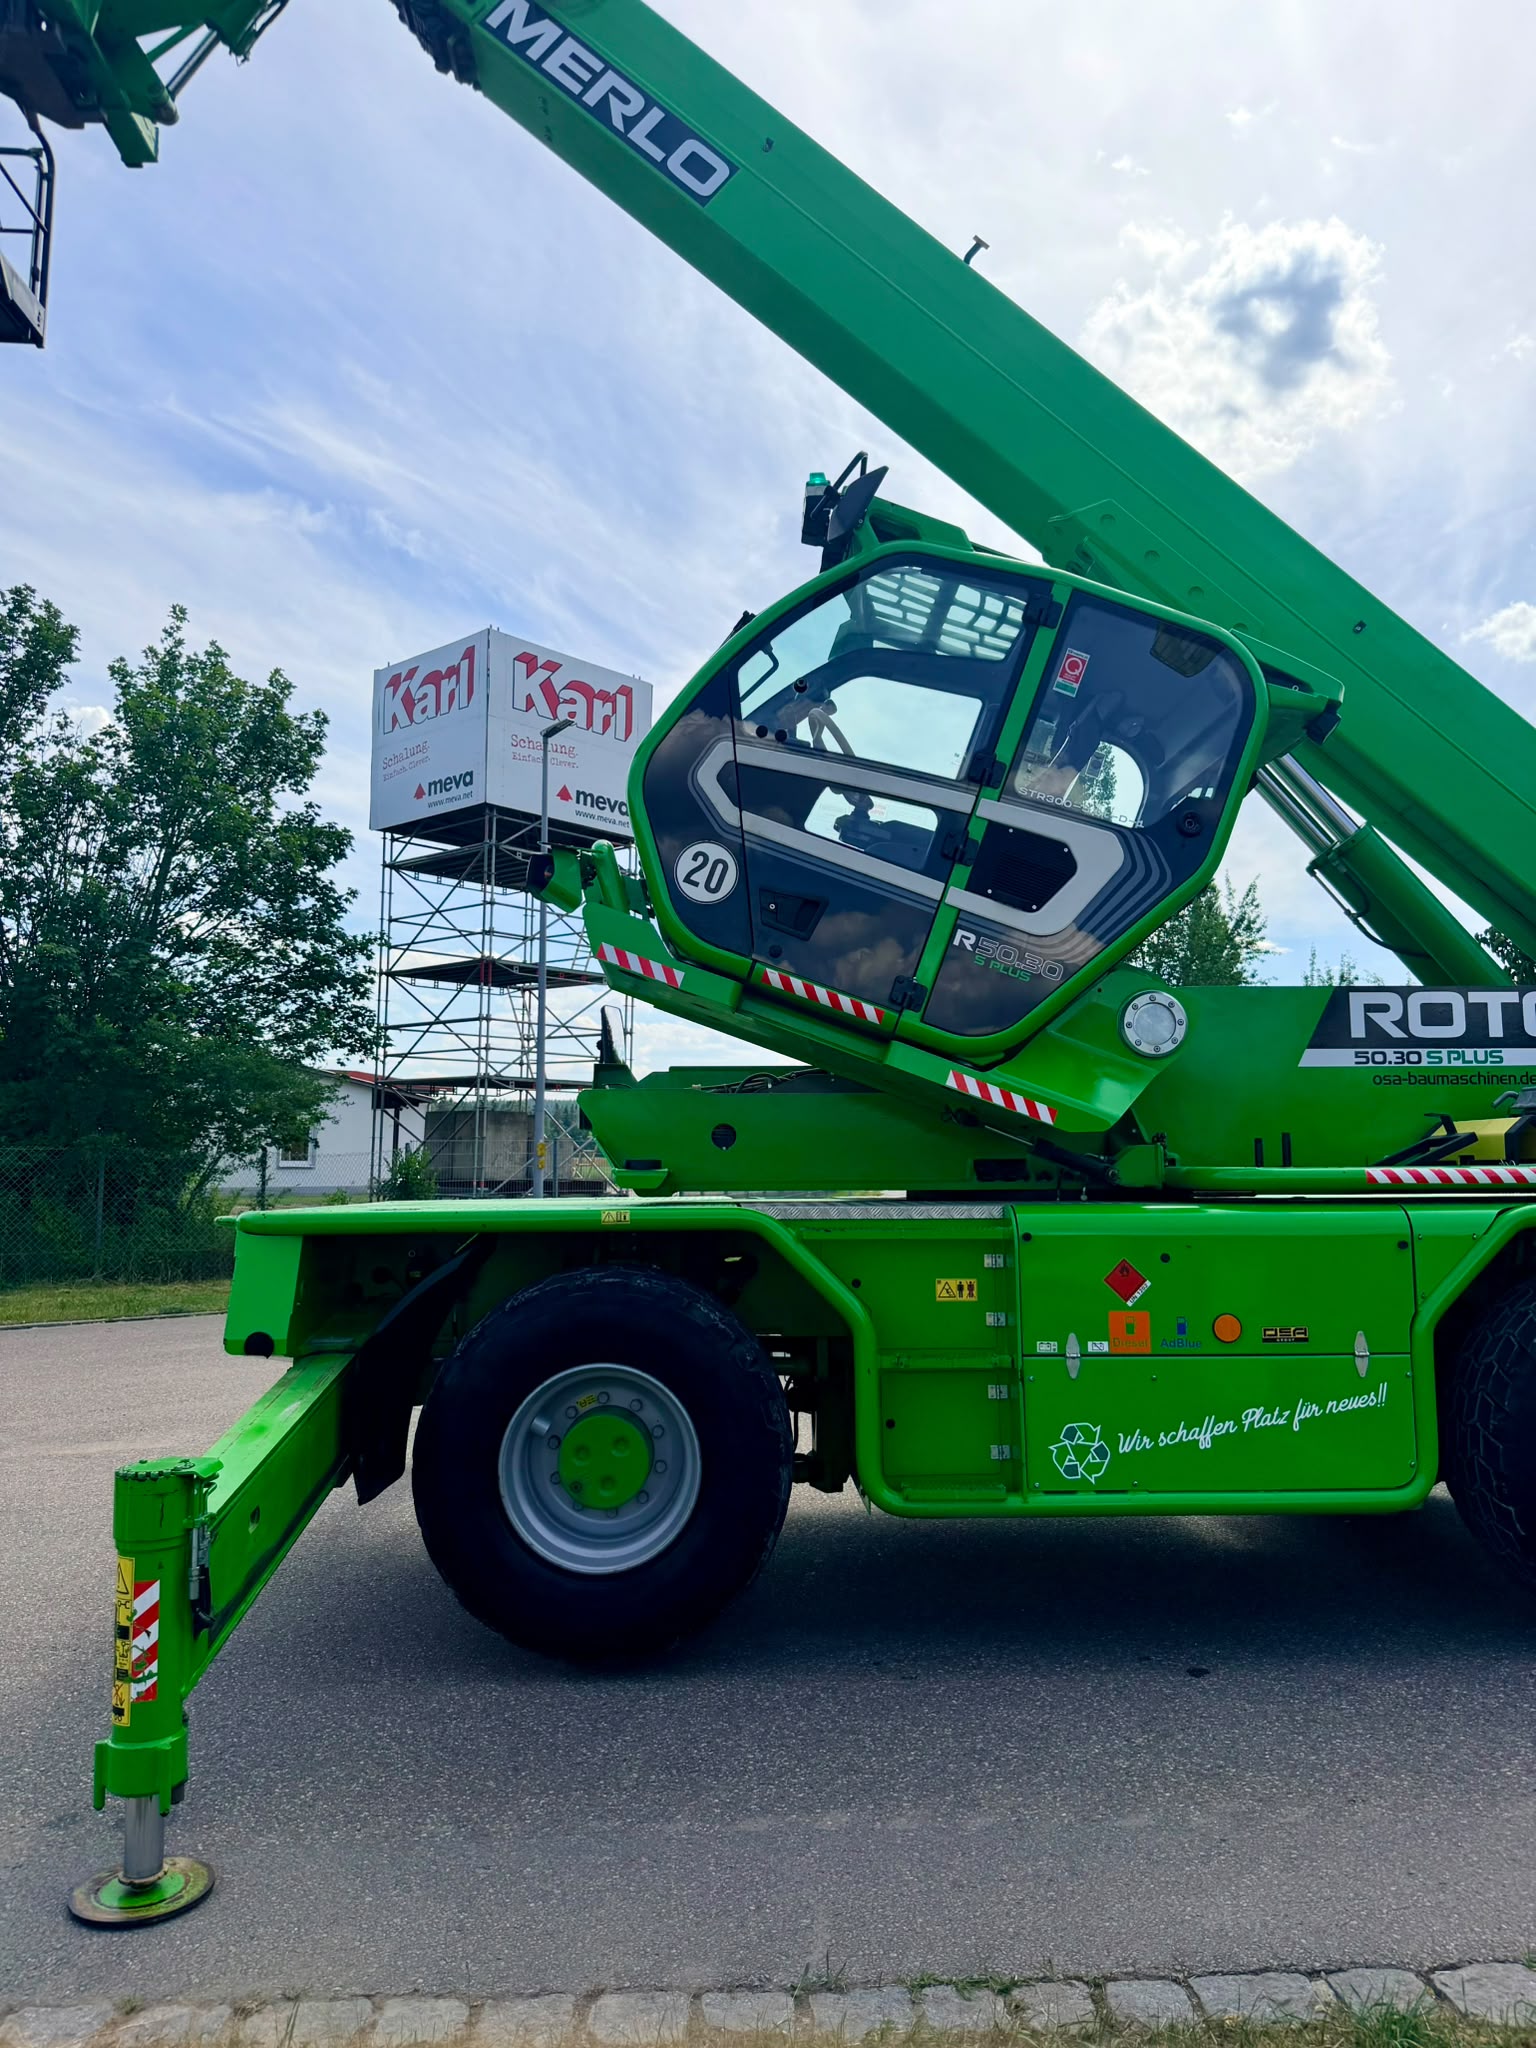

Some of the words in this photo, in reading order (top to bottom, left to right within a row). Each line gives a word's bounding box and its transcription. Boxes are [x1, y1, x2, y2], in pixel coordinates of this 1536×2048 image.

[485, 0, 730, 197] MERLO
[383, 645, 476, 735] Karl
[512, 651, 633, 742] Karl
[382, 740, 430, 770] Schalung.
[511, 734, 579, 759] Schaung.
[551, 757, 579, 769] Clever.
[428, 770, 474, 796] meva
[427, 790, 473, 808] www.meva.net
[575, 789, 630, 817] meva
[575, 809, 630, 828] www.meva.net
[683, 850, 729, 894] 20
[953, 929, 1064, 981] R50.30
[973, 954, 986, 966] S
[989, 959, 1032, 982] PLUS
[1349, 991, 1536, 1039] ROT
[1354, 1051, 1422, 1065] 50.30
[1427, 1050, 1443, 1065] S
[1447, 1050, 1504, 1065] PLUS
[1372, 1071, 1536, 1086] osa-baumaschinen.de
[1112, 1337, 1148, 1348] Diesel
[1160, 1339, 1202, 1349] AdBlue
[1118, 1429, 1155, 1453] Wir
[1158, 1415, 1238, 1449] schaffen
[1241, 1407, 1291, 1432] Platz
[1292, 1398, 1323, 1431] für
[1325, 1382, 1387, 1415] neues!!
